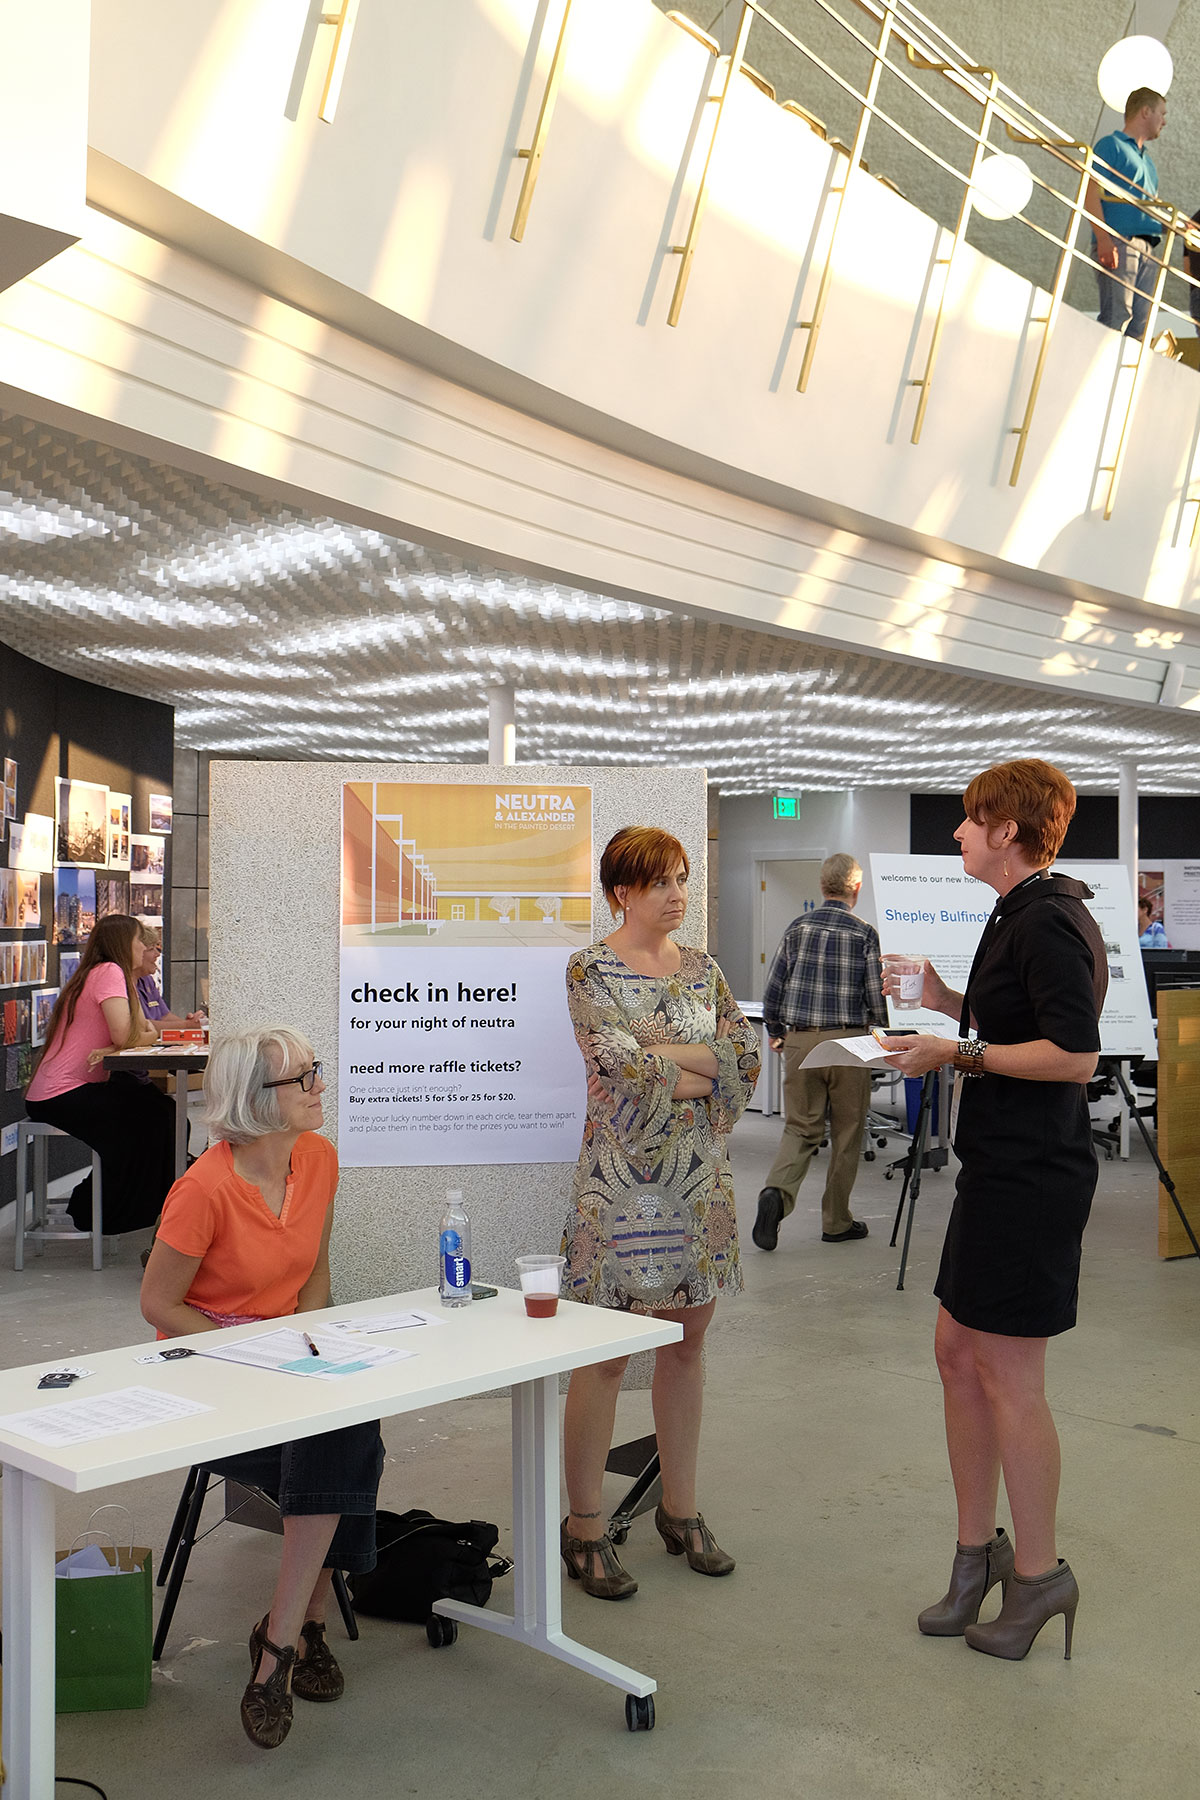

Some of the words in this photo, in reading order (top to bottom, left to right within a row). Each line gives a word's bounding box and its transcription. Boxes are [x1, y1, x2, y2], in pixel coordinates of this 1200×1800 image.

[495, 794, 576, 810] NEUTRA
[494, 811, 503, 821] &
[506, 812, 575, 822] ALEXANDER
[880, 874, 917, 882] welcome
[885, 908, 936, 924] Shepley
[350, 982, 420, 1003] check
[427, 982, 448, 1002] in
[458, 982, 517, 1002] here!
[350, 1016, 371, 1029] for
[374, 1018, 408, 1032] your
[411, 1016, 448, 1032] night
[452, 1016, 467, 1028] of
[470, 1018, 515, 1028] neutra
[350, 1062, 384, 1074] need
[388, 1064, 425, 1074] more
[429, 1060, 466, 1073] raffle
[470, 1060, 522, 1072] tickets?
[349, 1086, 366, 1094] One
[368, 1085, 395, 1094] chance
[396, 1086, 410, 1094] just
[412, 1084, 428, 1092] isn't
[428, 1084, 462, 1094] enough?
[350, 1096, 366, 1104] Buy
[392, 1094, 422, 1102] tickets!
[432, 1094, 445, 1102] for
[447, 1094, 458, 1102] $5
[484, 1093, 496, 1101] for
[348, 1114, 370, 1122] Write
[372, 1116, 389, 1124] your
[391, 1114, 410, 1124] lucky
[444, 1113, 464, 1121] down
[476, 1112, 494, 1120] each
[495, 1112, 516, 1120] circle,
[534, 1112, 554, 1120] them
[366, 1125, 386, 1134] place
[433, 1124, 452, 1132] bags
[480, 1122, 502, 1132] prizes
[504, 1123, 518, 1132] you
[549, 1120, 564, 1128] win!
[454, 1256, 464, 1288] smart
